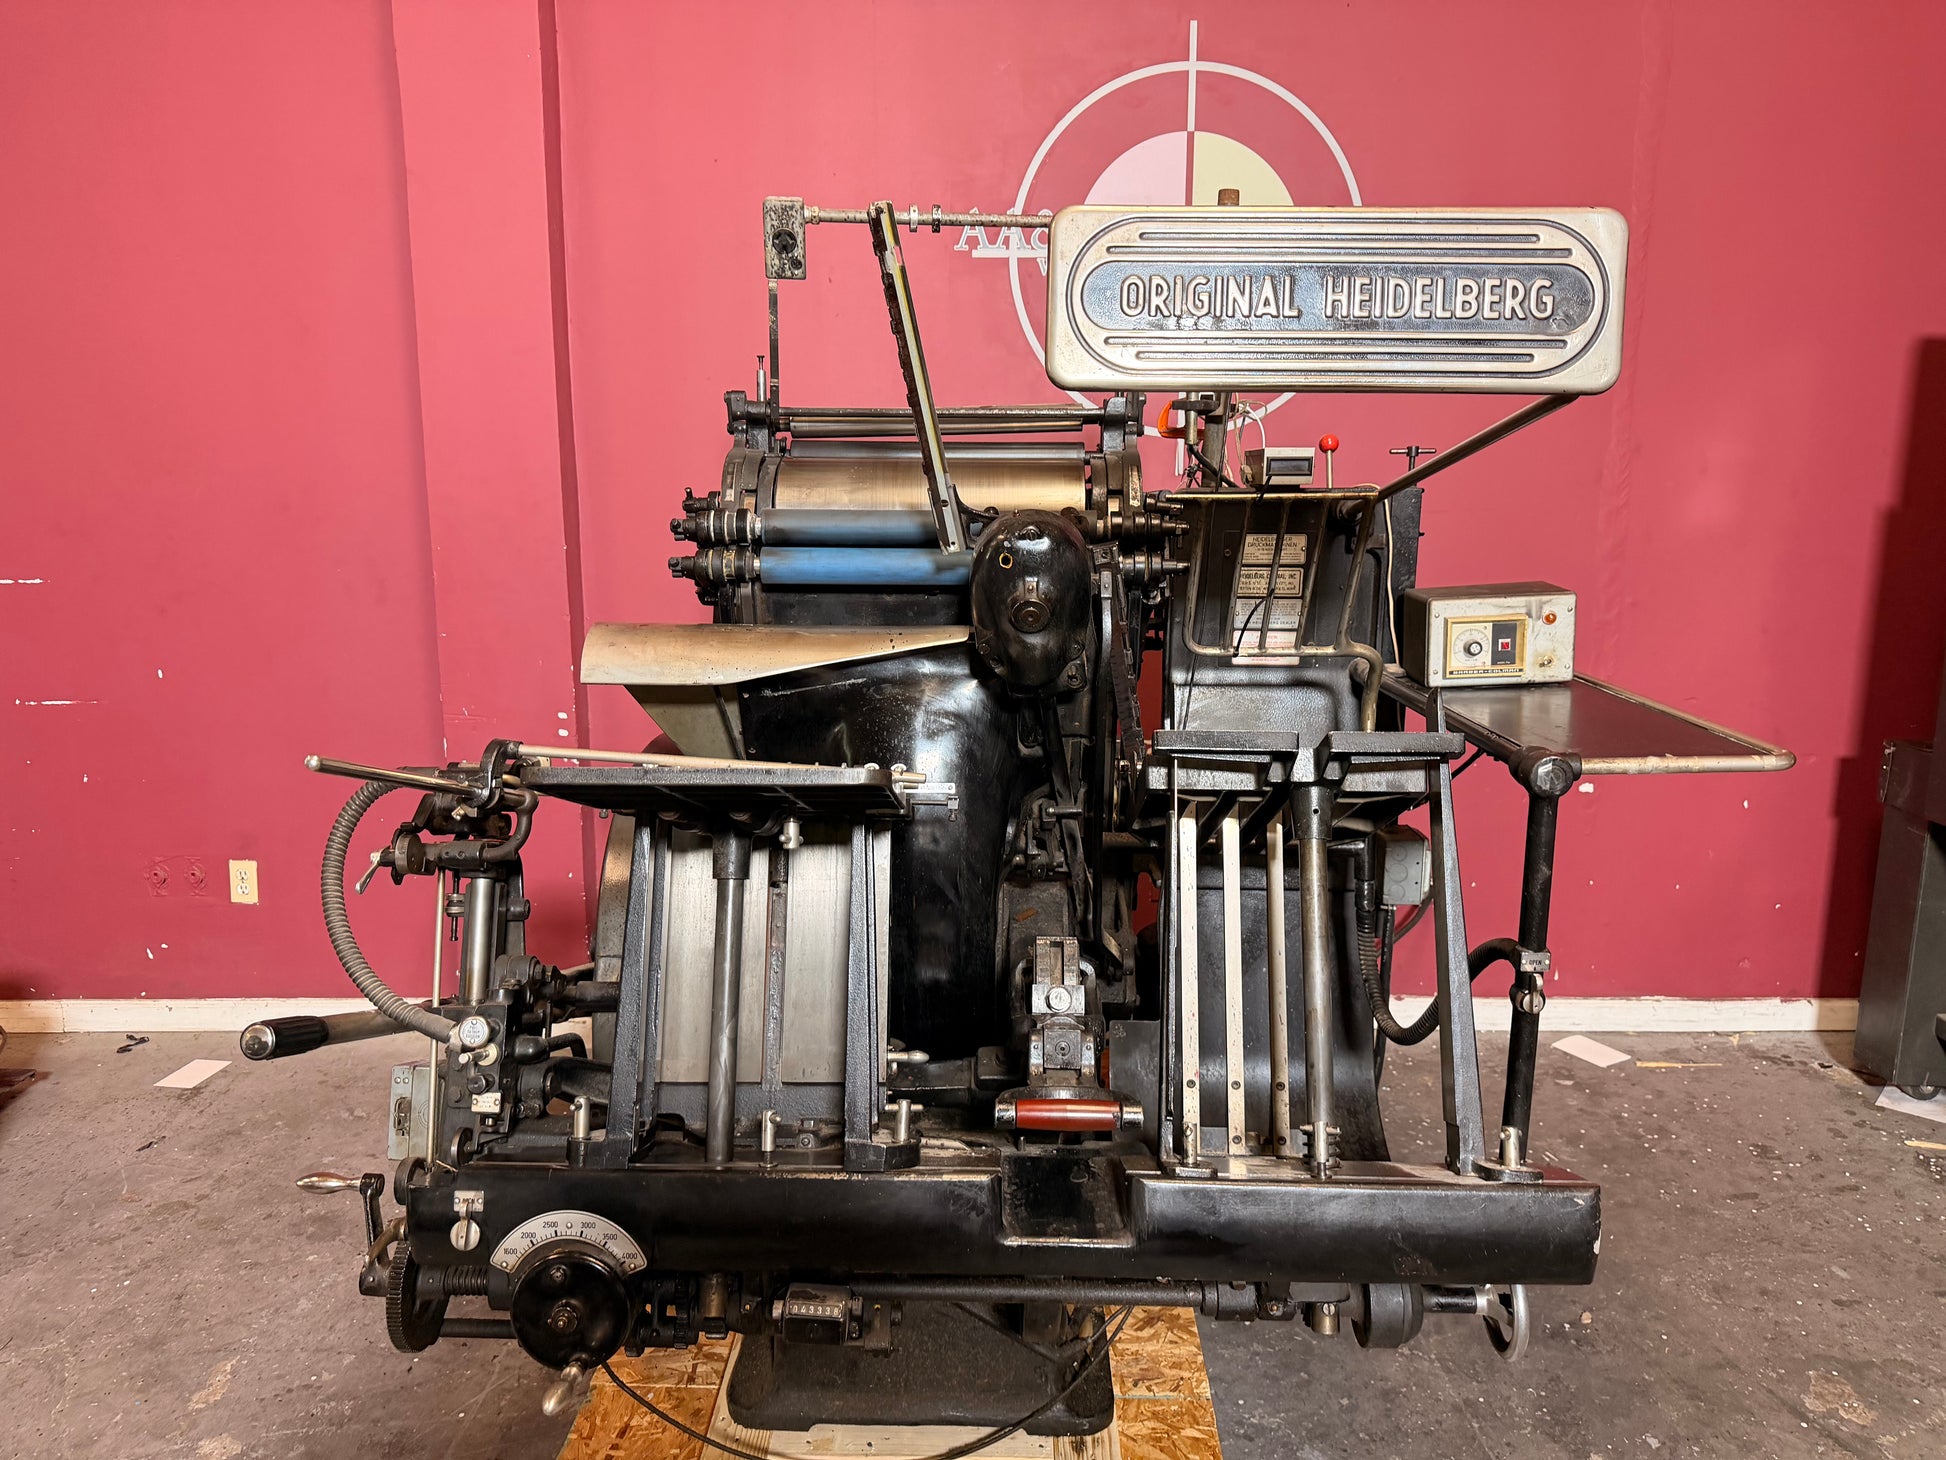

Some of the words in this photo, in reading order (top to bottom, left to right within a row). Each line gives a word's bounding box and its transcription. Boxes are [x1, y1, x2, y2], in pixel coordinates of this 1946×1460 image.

[1119, 273, 1301, 318] ORIGINAL
[1324, 275, 1554, 320] HEIDELBERG
[542, 1220, 558, 1228] 2500
[581, 1221, 596, 1229] 3000
[521, 1231, 536, 1239] 2000
[603, 1232, 618, 1240] 3500
[622, 1252, 637, 1260] 4000
